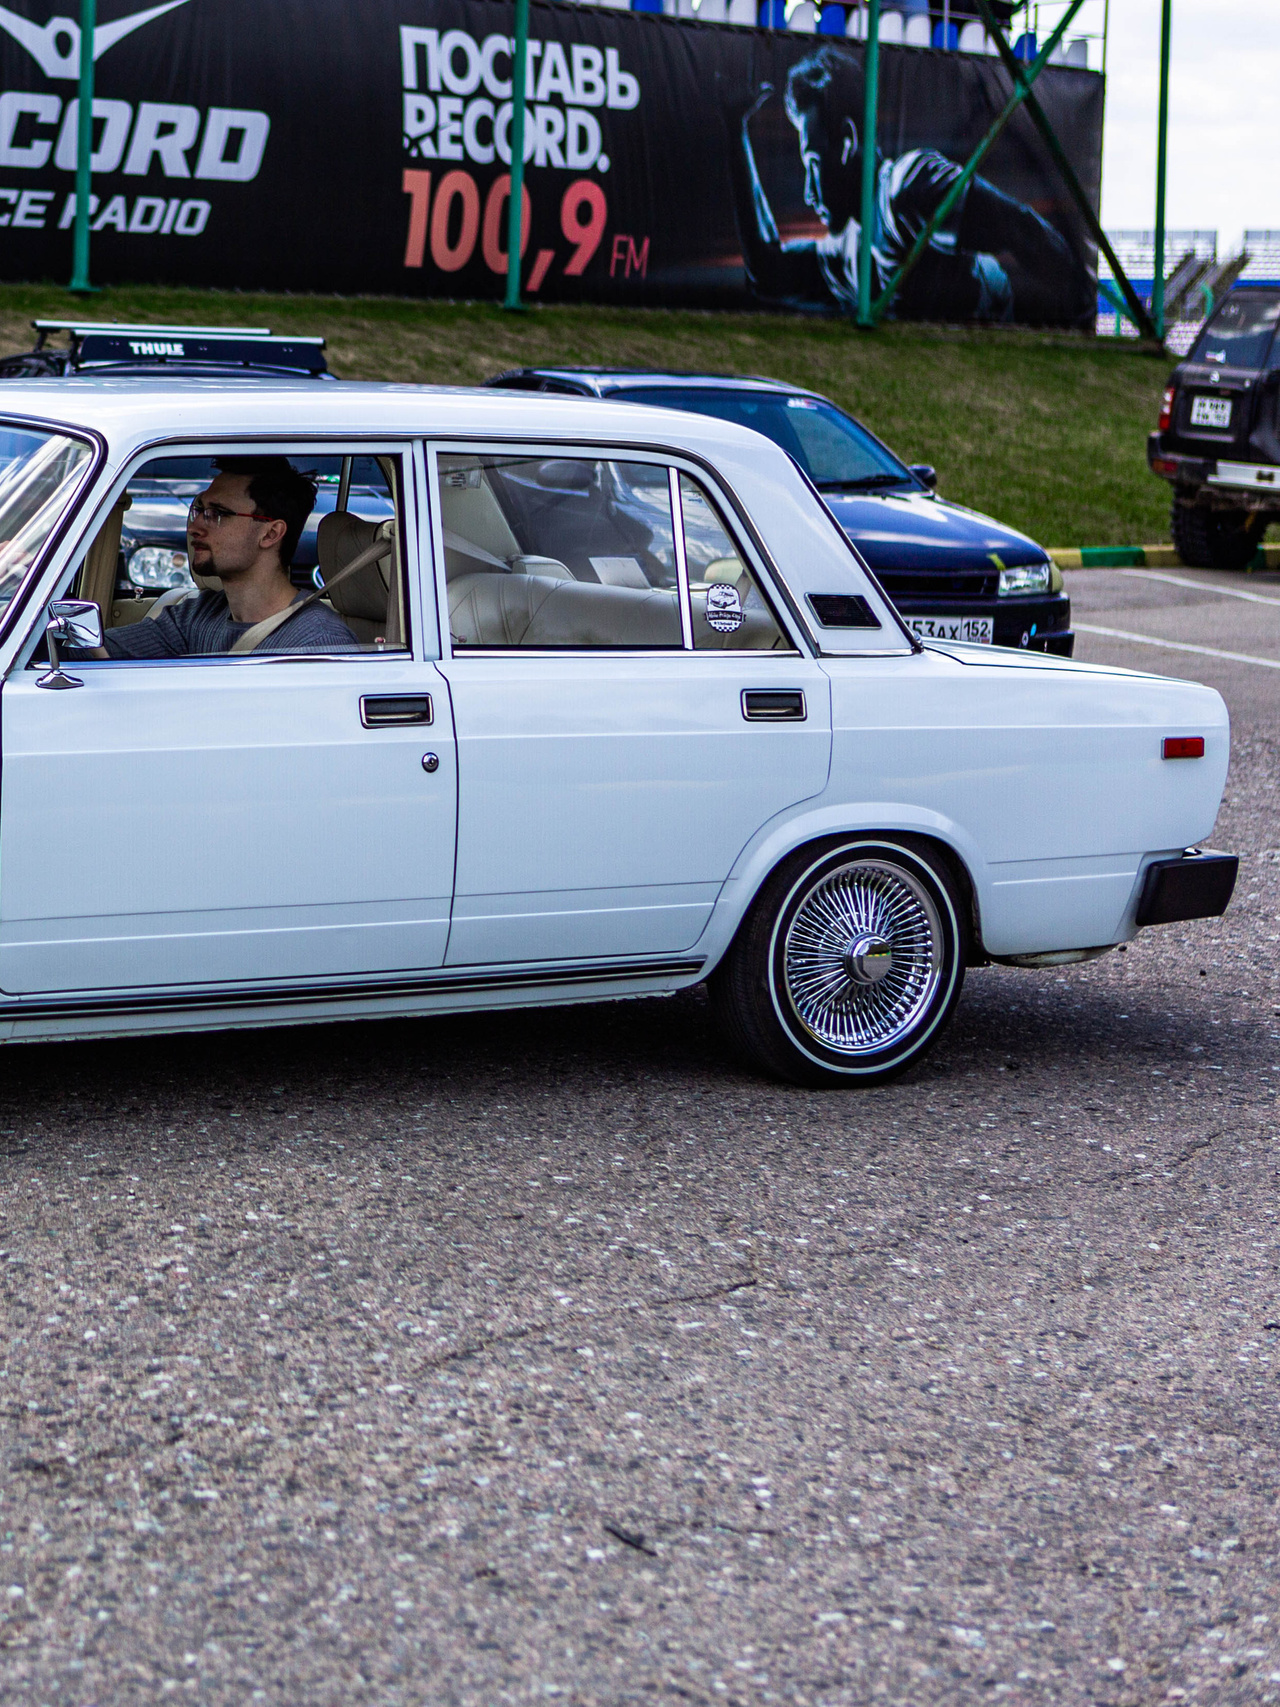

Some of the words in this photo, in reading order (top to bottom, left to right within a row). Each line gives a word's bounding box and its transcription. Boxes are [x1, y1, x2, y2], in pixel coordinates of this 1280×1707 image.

[399, 25, 641, 110] ПОСТАВЬ
[403, 92, 610, 173] RECORD.
[58, 191, 212, 236] RADIO
[402, 168, 607, 291] 100,9
[610, 234, 650, 279] FM
[129, 342, 184, 356] THULE
[963, 621, 988, 637] 152
